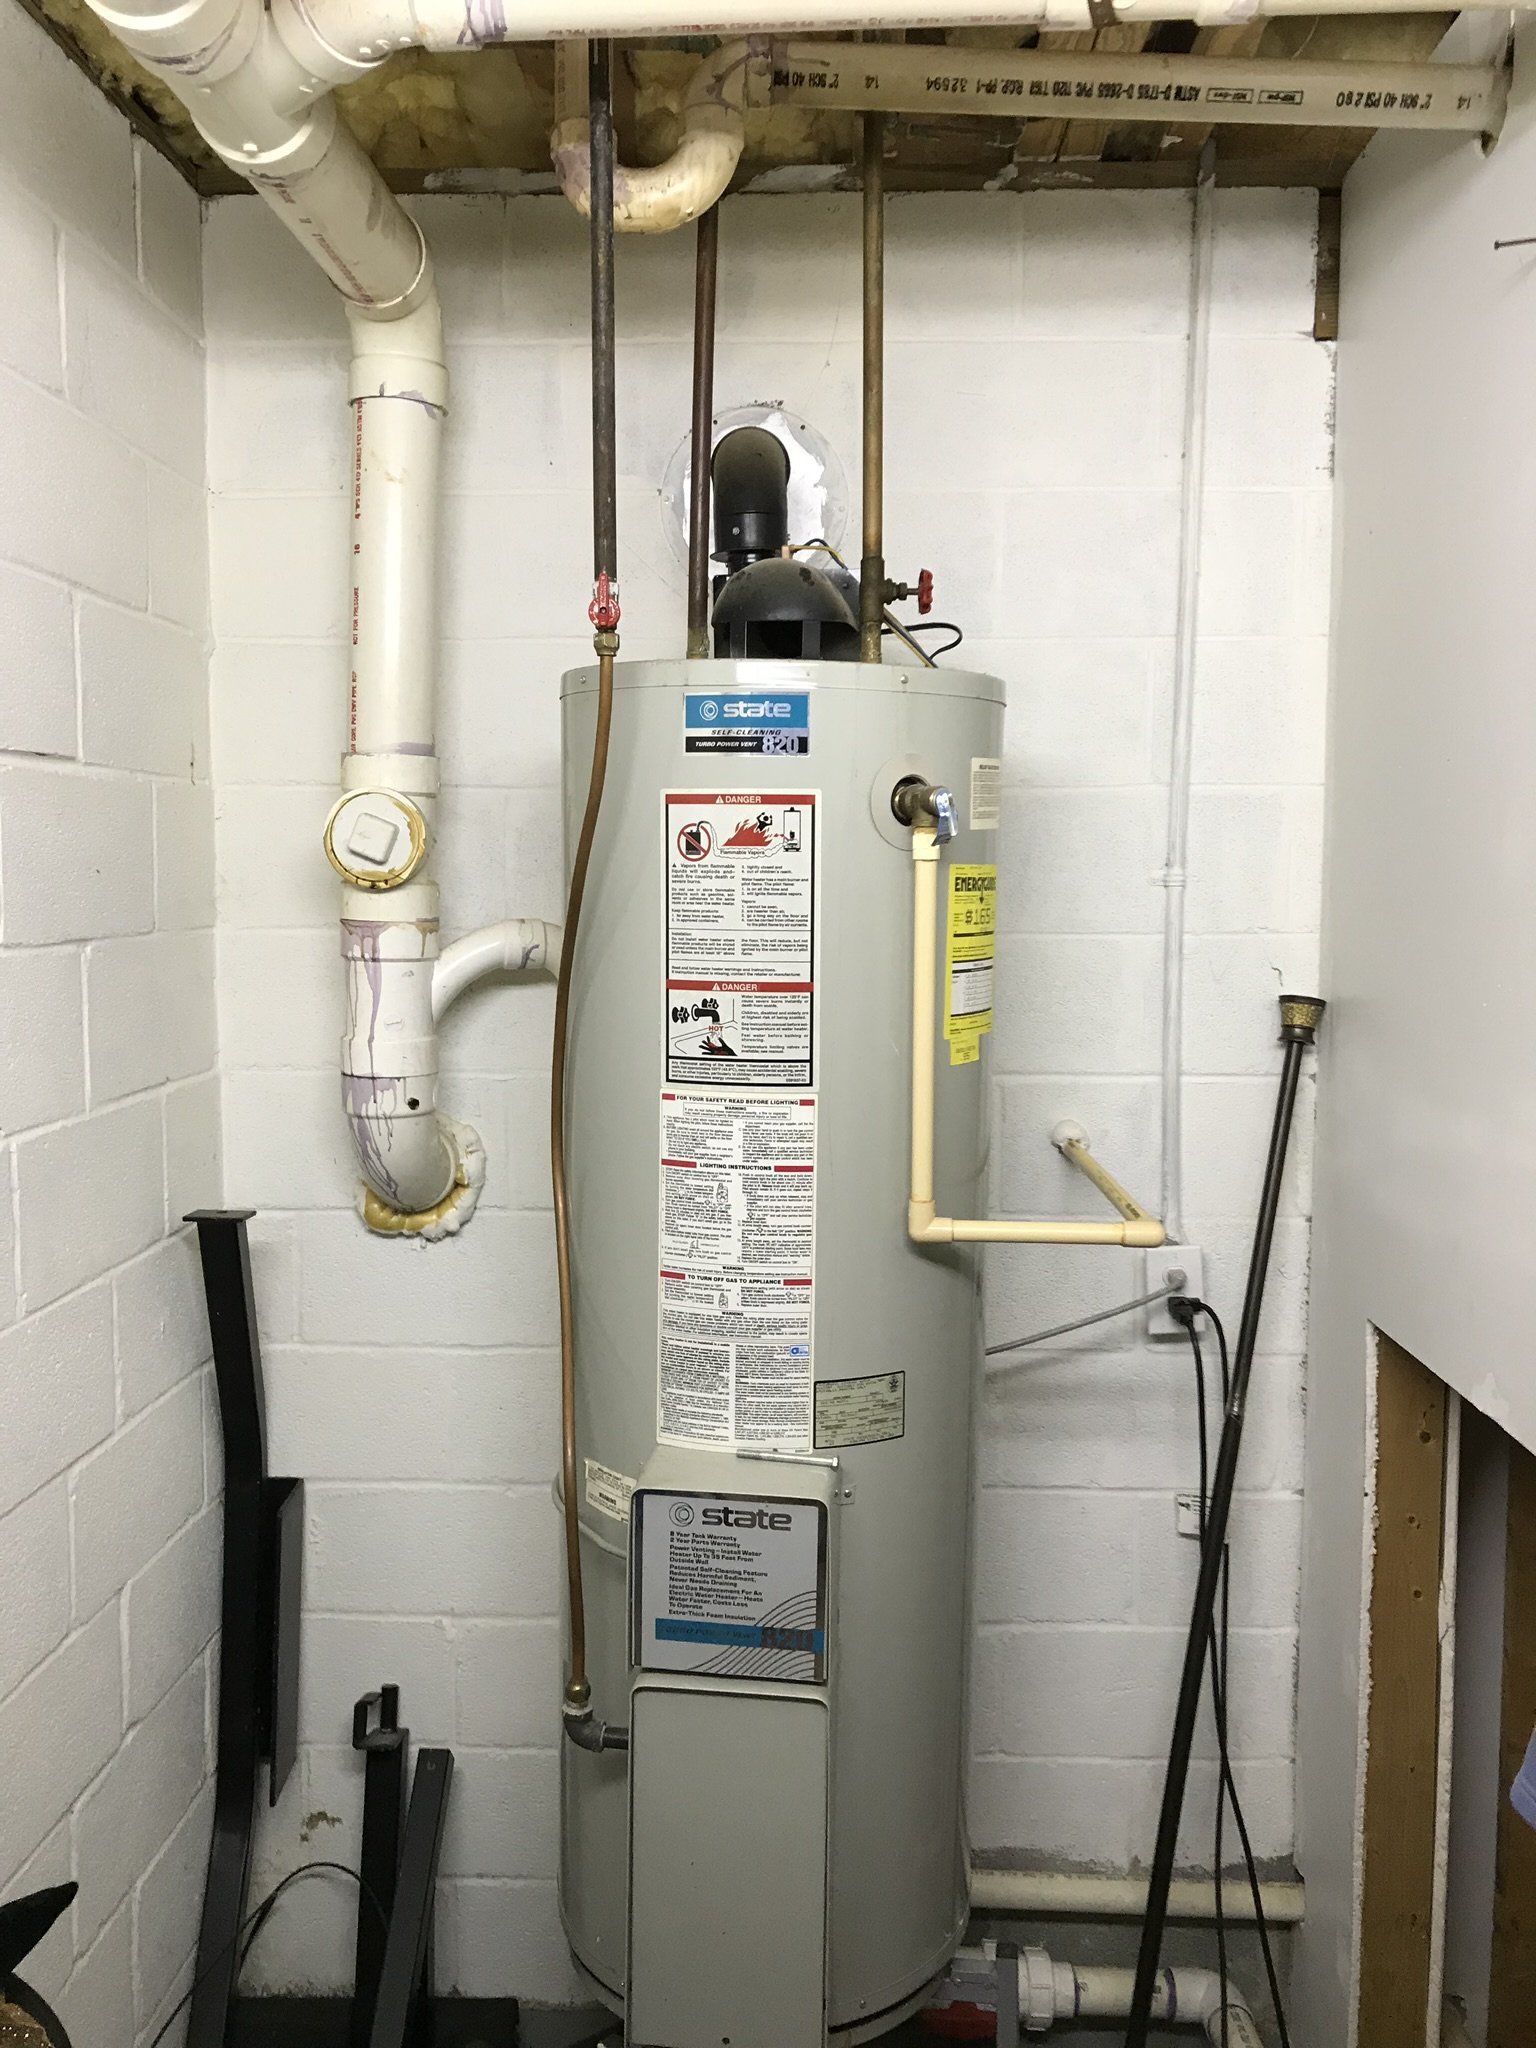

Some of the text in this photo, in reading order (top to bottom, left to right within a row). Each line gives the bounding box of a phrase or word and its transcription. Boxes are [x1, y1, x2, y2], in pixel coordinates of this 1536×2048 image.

[792, 72, 805, 87] 40
[864, 75, 879, 89] 14
[1383, 91, 1397, 108] 40
[723, 700, 791, 718] state
[762, 735, 799, 754] 820
[725, 795, 762, 804] DANGER
[721, 983, 758, 991] DANGER
[702, 1506, 792, 1531] state
[706, 1533, 737, 1542] Warranty
[691, 1538, 710, 1546] Parts
[710, 1540, 741, 1548] Warranty
[691, 1546, 715, 1554] Venting
[669, 1556, 694, 1564] Outside
[669, 1563, 768, 1577] Patented Self-Cleaning Feature
[669, 1570, 757, 1583] Reduces Harmful Sediment,
[710, 1579, 738, 1588] Draining
[668, 1589, 694, 1597] Electric
[698, 1585, 740, 1595] Replacement
[677, 1602, 703, 1610] Operate
[689, 1597, 712, 1605] Faster,
[668, 1609, 705, 1617] Extra-Thick
[724, 1613, 756, 1621] Insulation
